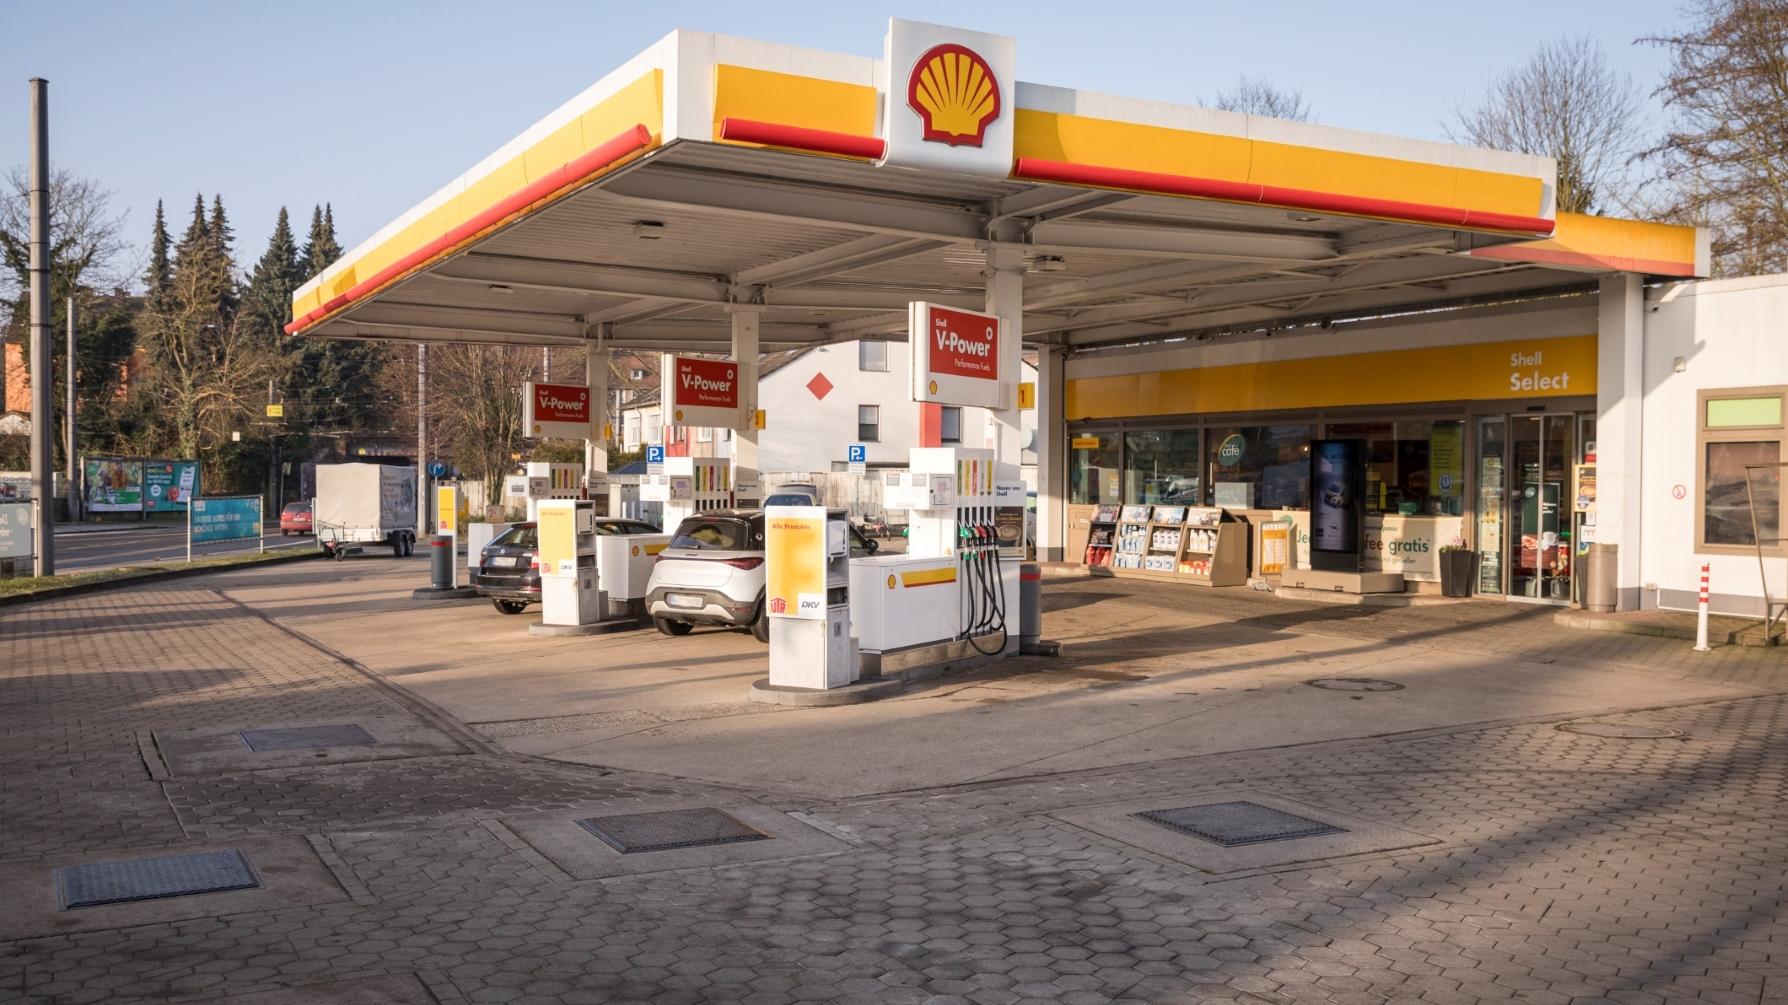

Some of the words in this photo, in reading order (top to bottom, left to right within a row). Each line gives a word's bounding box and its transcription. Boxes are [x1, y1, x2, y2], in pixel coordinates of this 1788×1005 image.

[935, 329, 990, 357] V-Power
[954, 358, 980, 370] Performance
[1510, 351, 1543, 367] Shell
[681, 373, 731, 392] V-Power
[1510, 370, 1569, 391] Select
[539, 396, 584, 410] V-Power
[1020, 389, 1025, 404] 1
[649, 447, 660, 461] P
[851, 447, 861, 460] P
[801, 601, 820, 609] DKV
